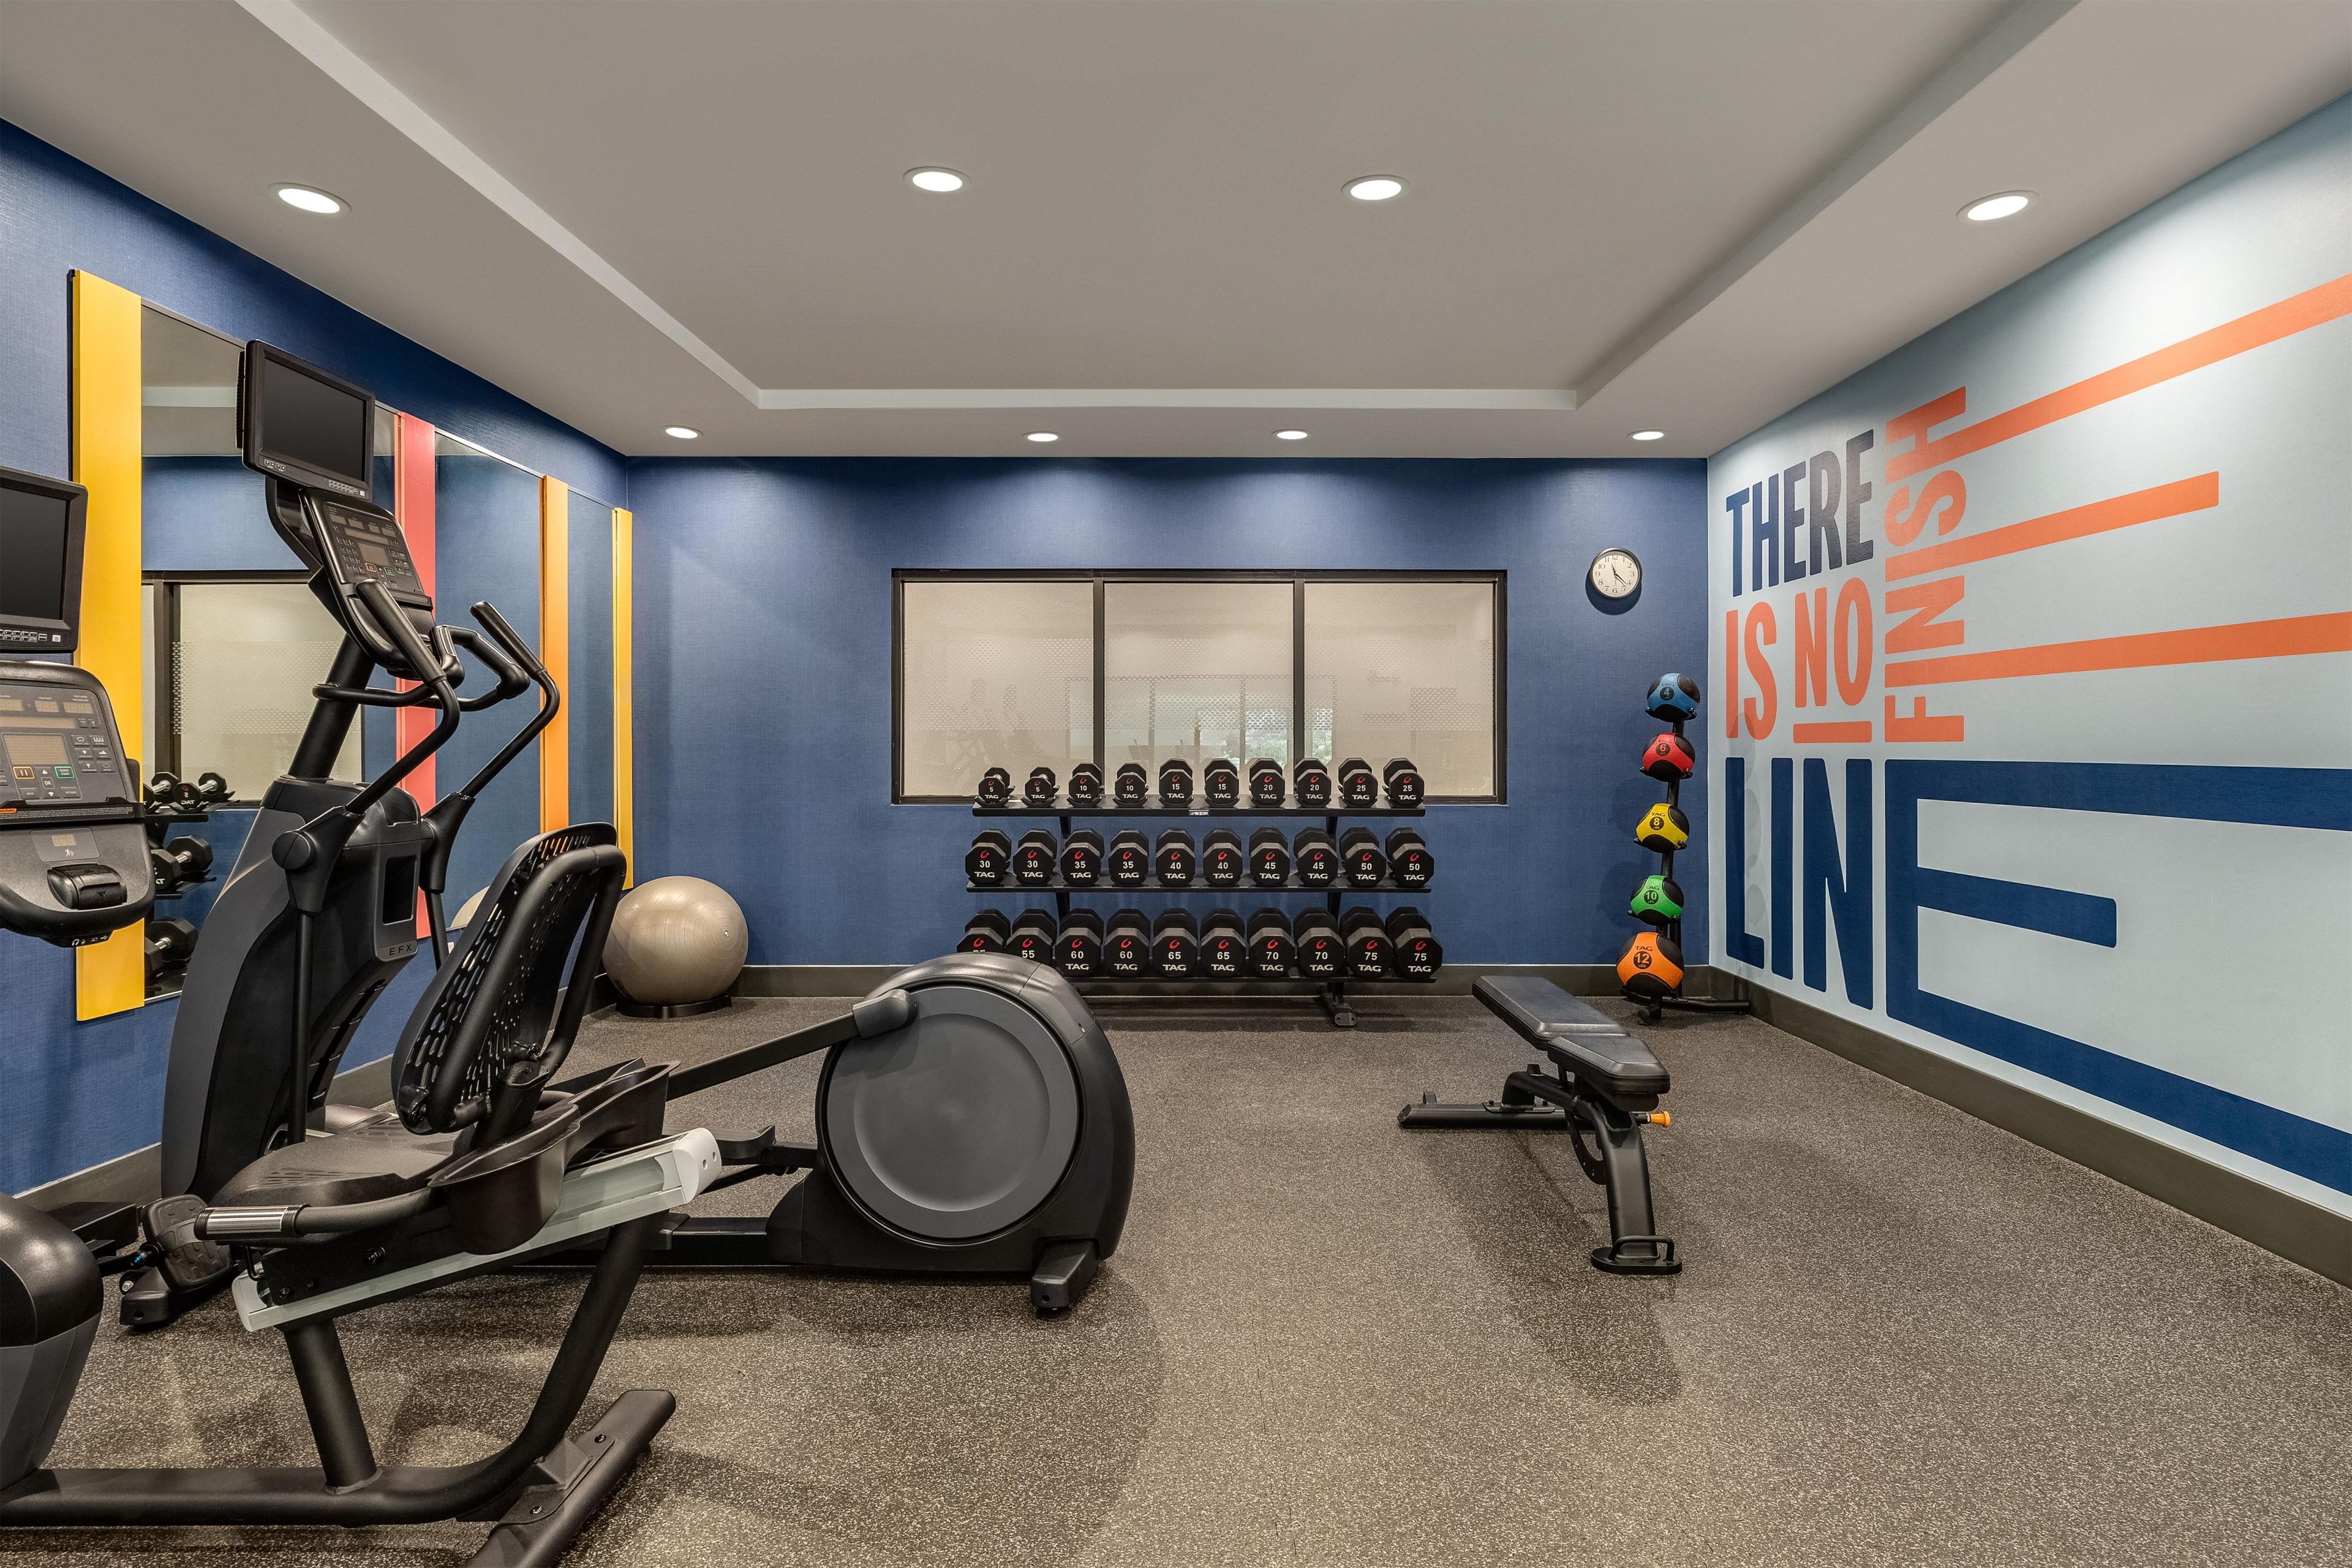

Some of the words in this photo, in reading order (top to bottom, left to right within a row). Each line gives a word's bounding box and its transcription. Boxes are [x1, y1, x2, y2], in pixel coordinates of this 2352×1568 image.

[1726, 429, 1874, 597] THERE
[1726, 601, 1777, 741] IS
[1795, 578, 1873, 709] NO
[1664, 687, 1670, 696] 4
[1654, 817, 1660, 826] 8
[1646, 891, 1657, 900] 10
[1635, 953, 1649, 963] 12
